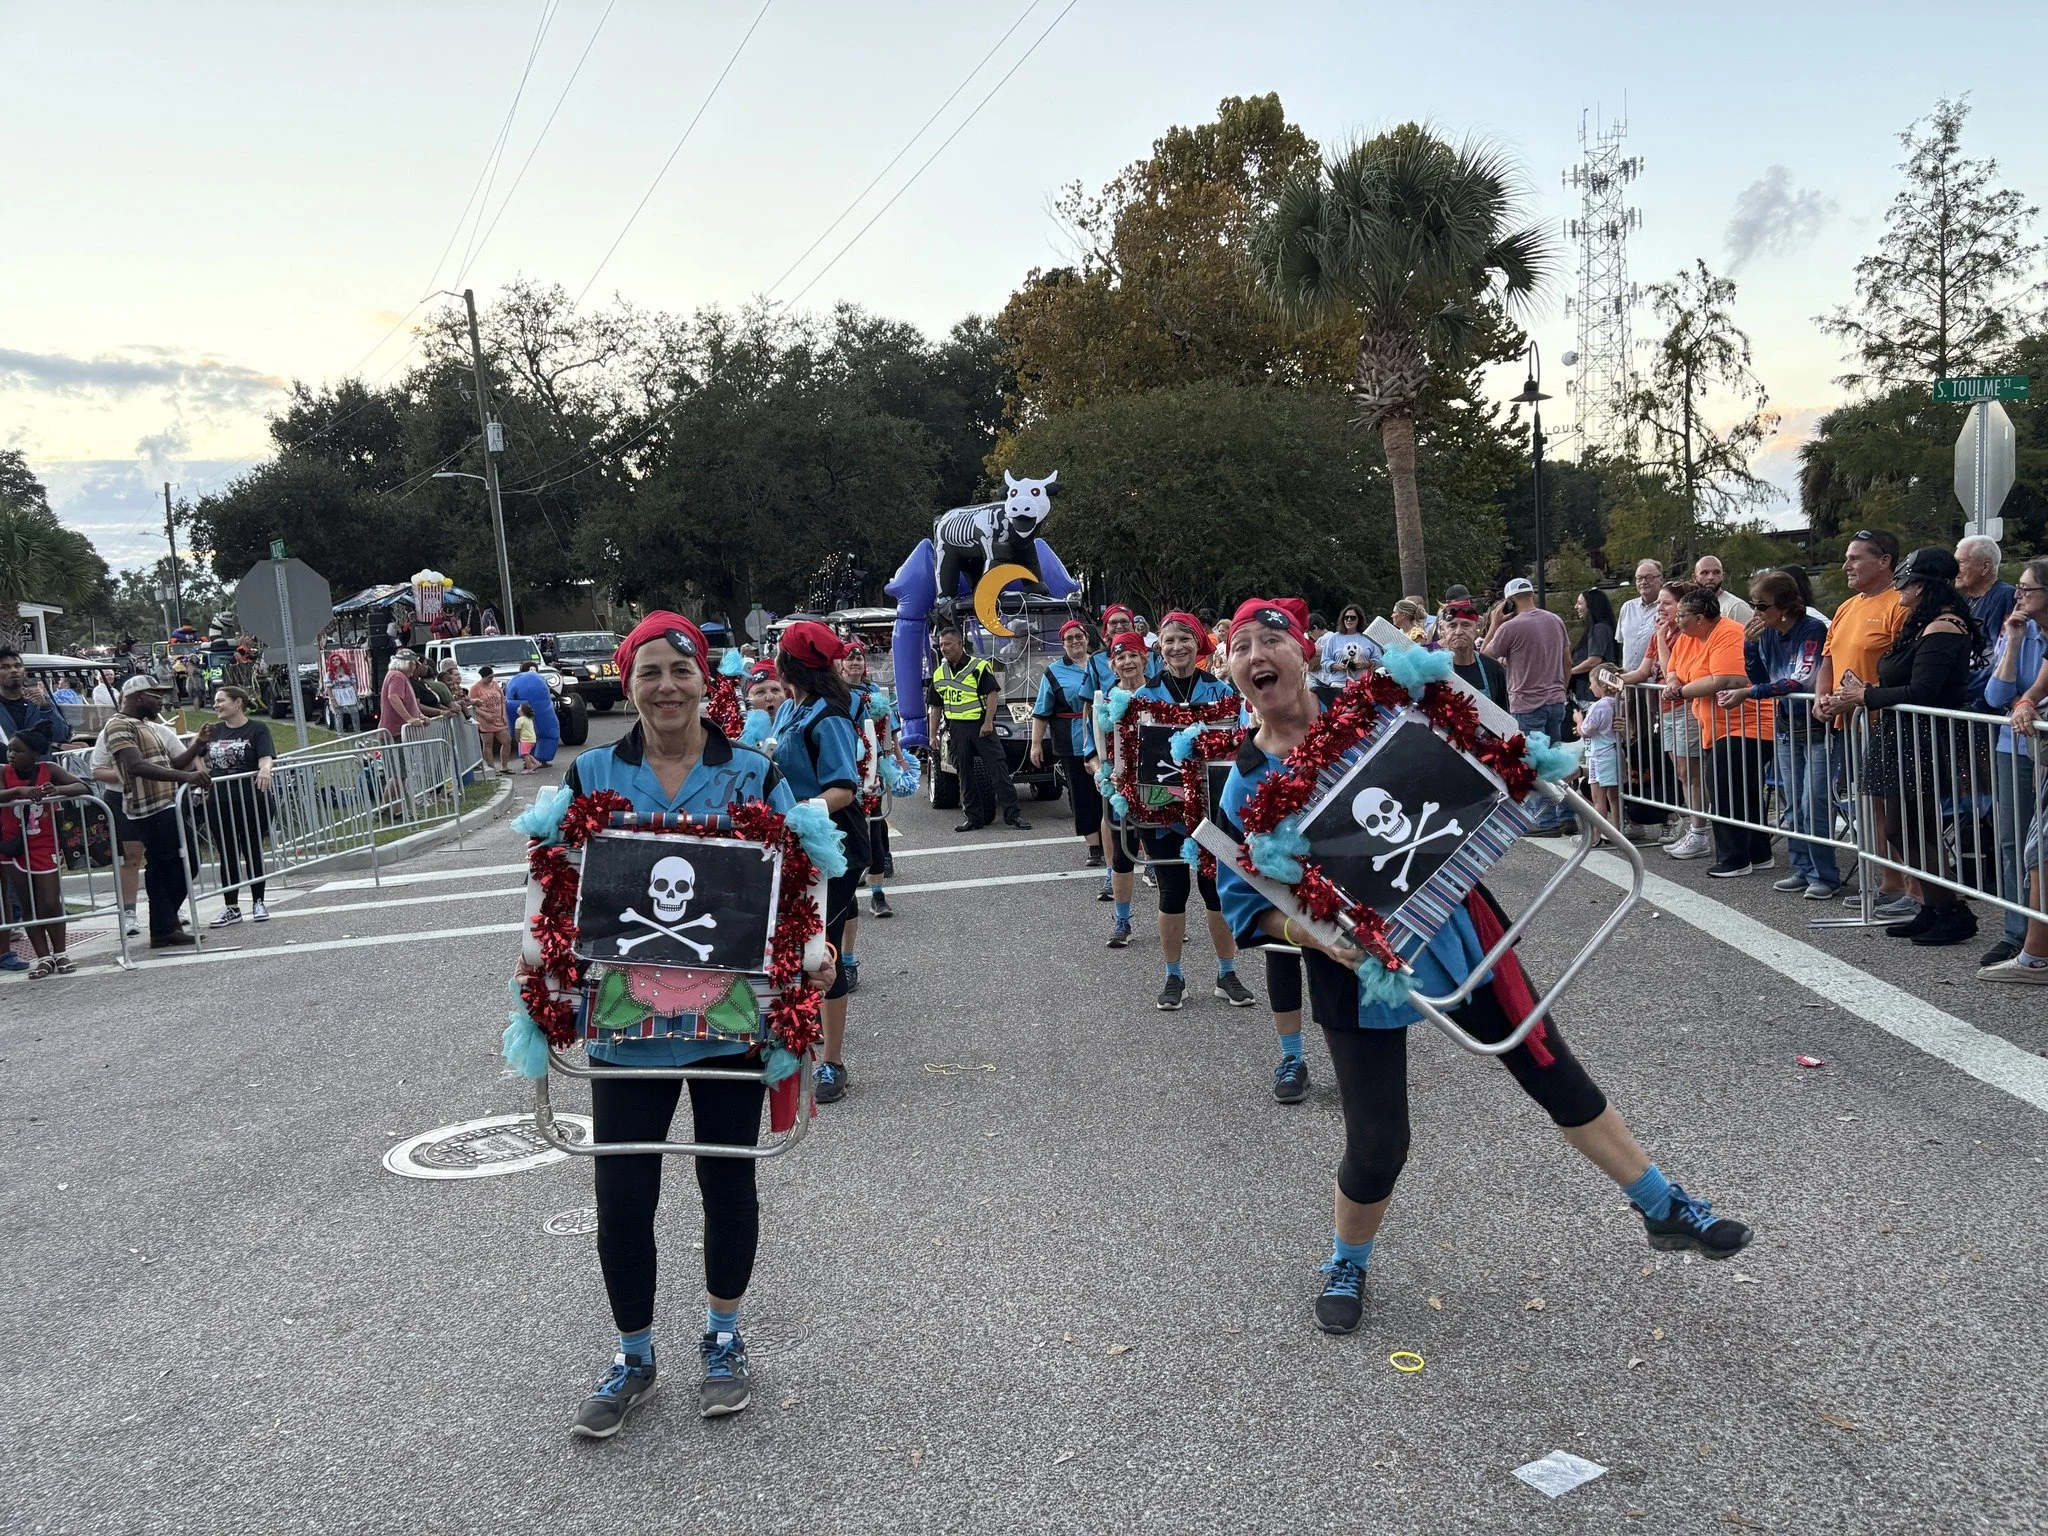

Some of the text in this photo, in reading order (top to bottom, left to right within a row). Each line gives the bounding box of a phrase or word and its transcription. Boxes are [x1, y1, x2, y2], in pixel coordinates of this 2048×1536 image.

[1937, 378, 2012, 398] S. TOULME ST
[1545, 422, 1583, 435] LOUIS
